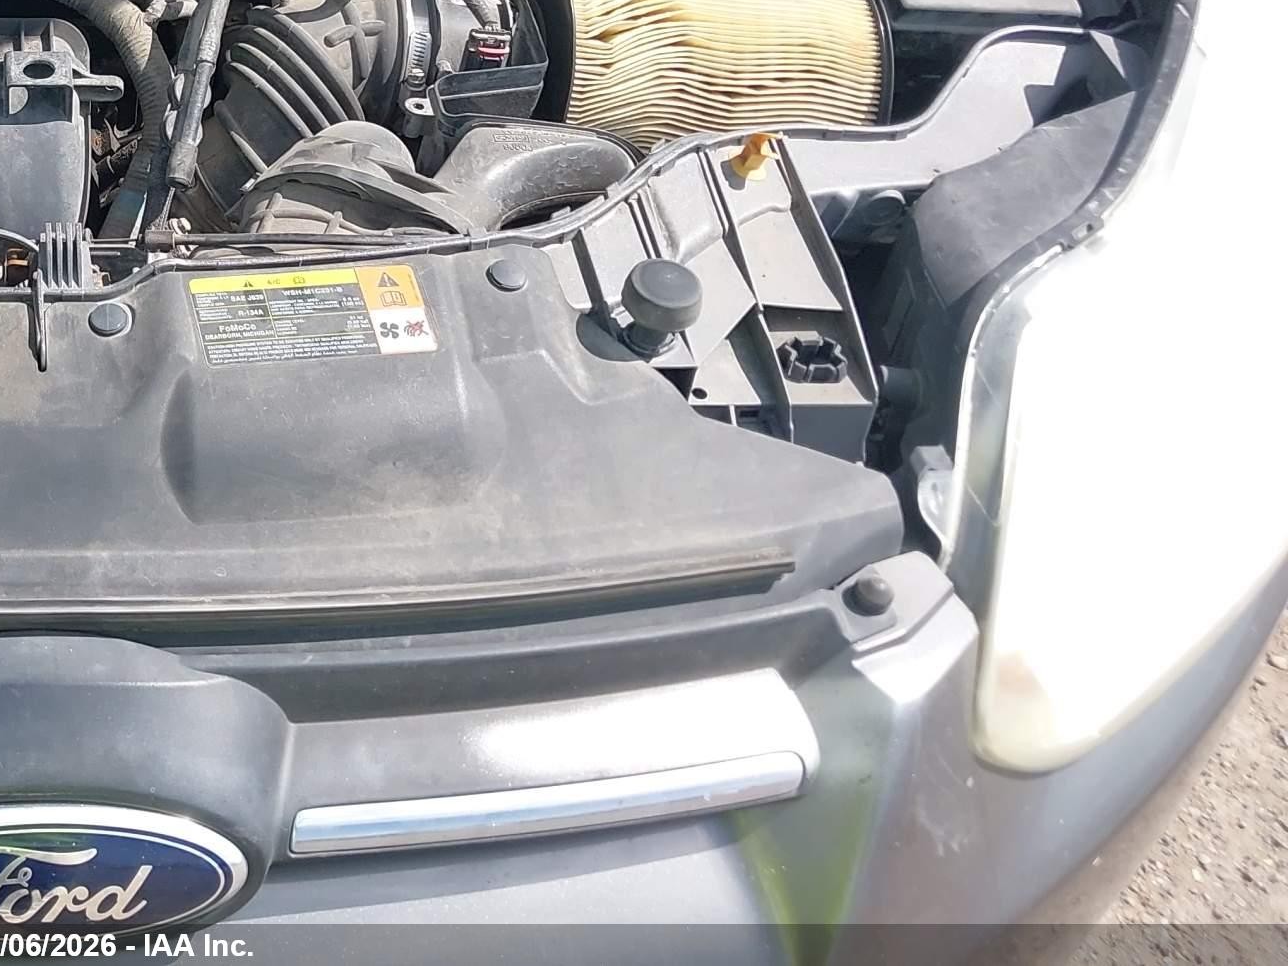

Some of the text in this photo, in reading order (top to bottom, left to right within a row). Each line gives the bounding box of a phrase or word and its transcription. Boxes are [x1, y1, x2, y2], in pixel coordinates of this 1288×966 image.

[238, 308, 264, 317] R-134A
[219, 323, 257, 333] FoMoCo
[243, 329, 275, 338] MICHIGAN
